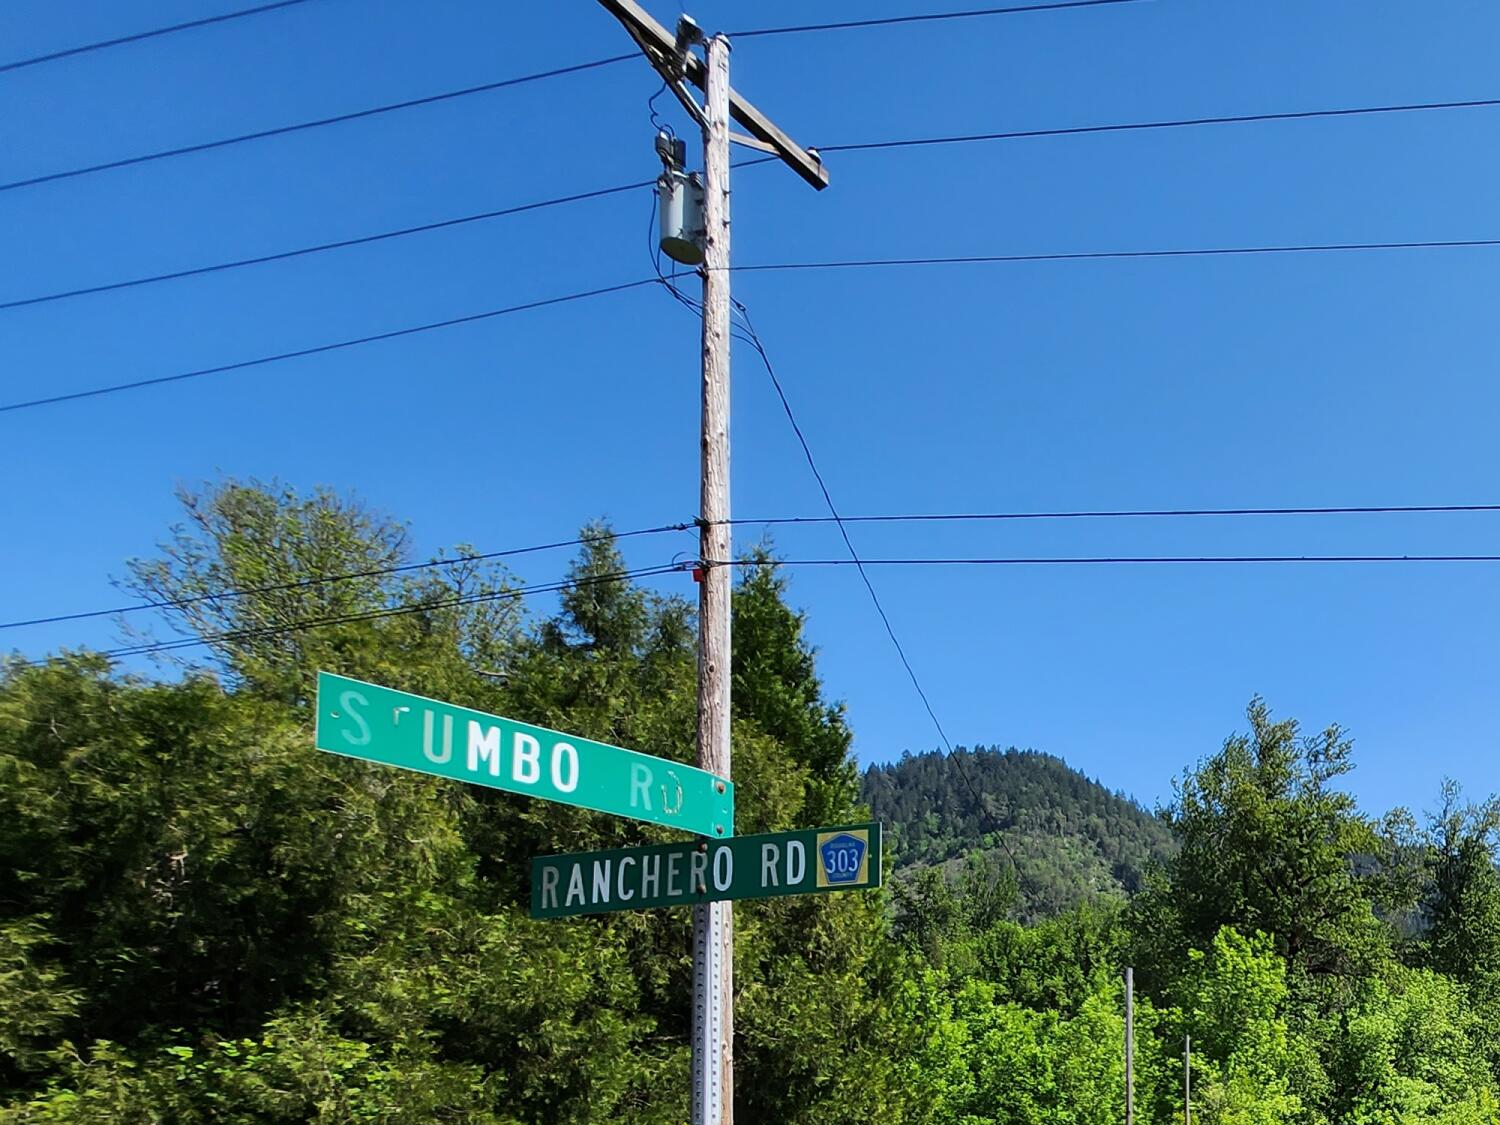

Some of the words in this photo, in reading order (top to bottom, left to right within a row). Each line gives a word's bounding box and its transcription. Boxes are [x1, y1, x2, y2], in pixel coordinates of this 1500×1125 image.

[541, 845, 734, 909] RANCHERO
[761, 839, 807, 888] RD
[826, 848, 859, 874] 303
